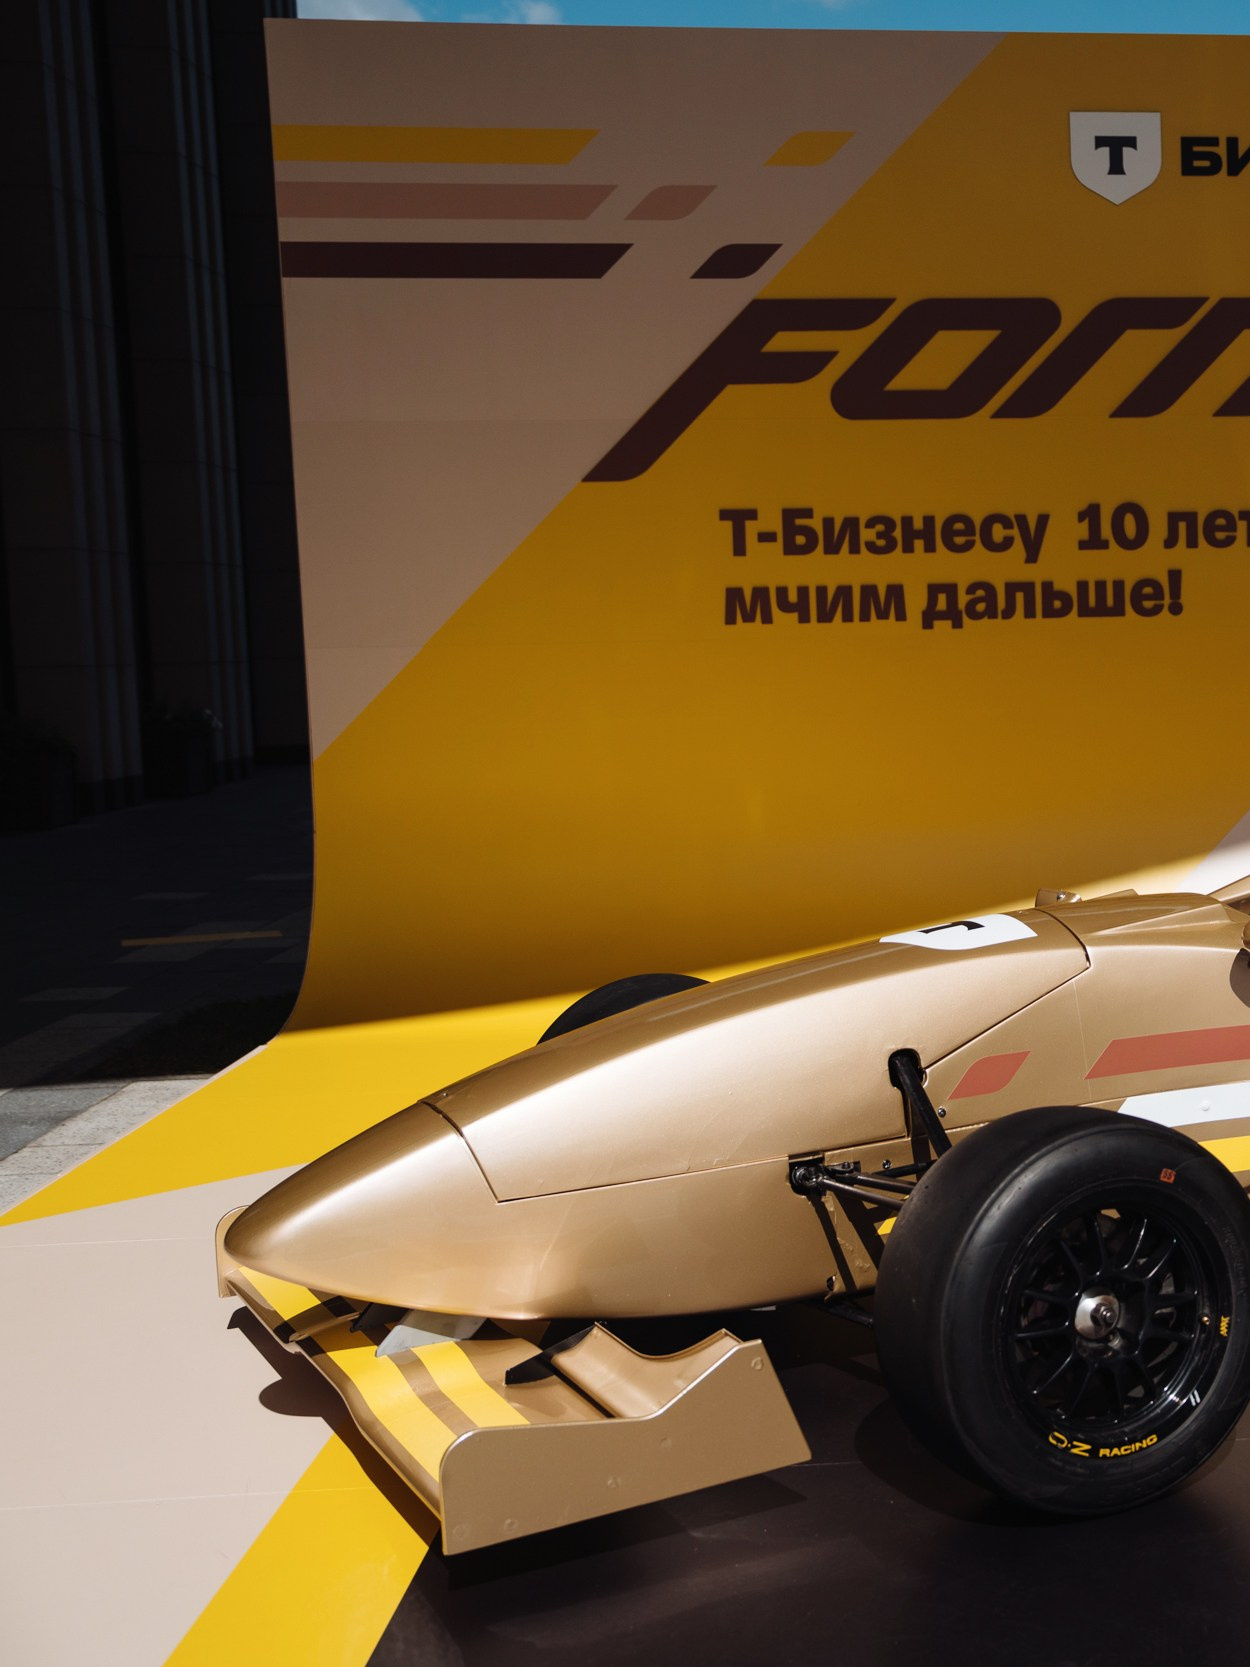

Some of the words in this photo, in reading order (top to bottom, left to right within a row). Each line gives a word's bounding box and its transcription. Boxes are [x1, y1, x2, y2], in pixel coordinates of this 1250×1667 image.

[1094, 135, 1138, 176] Т
[719, 507, 1050, 563] Т-Бизнесу
[1077, 502, 1150, 551] 10
[724, 583, 907, 625] мчим
[922, 569, 1184, 629] дальше!
[1099, 1433, 1158, 1457] RACING
